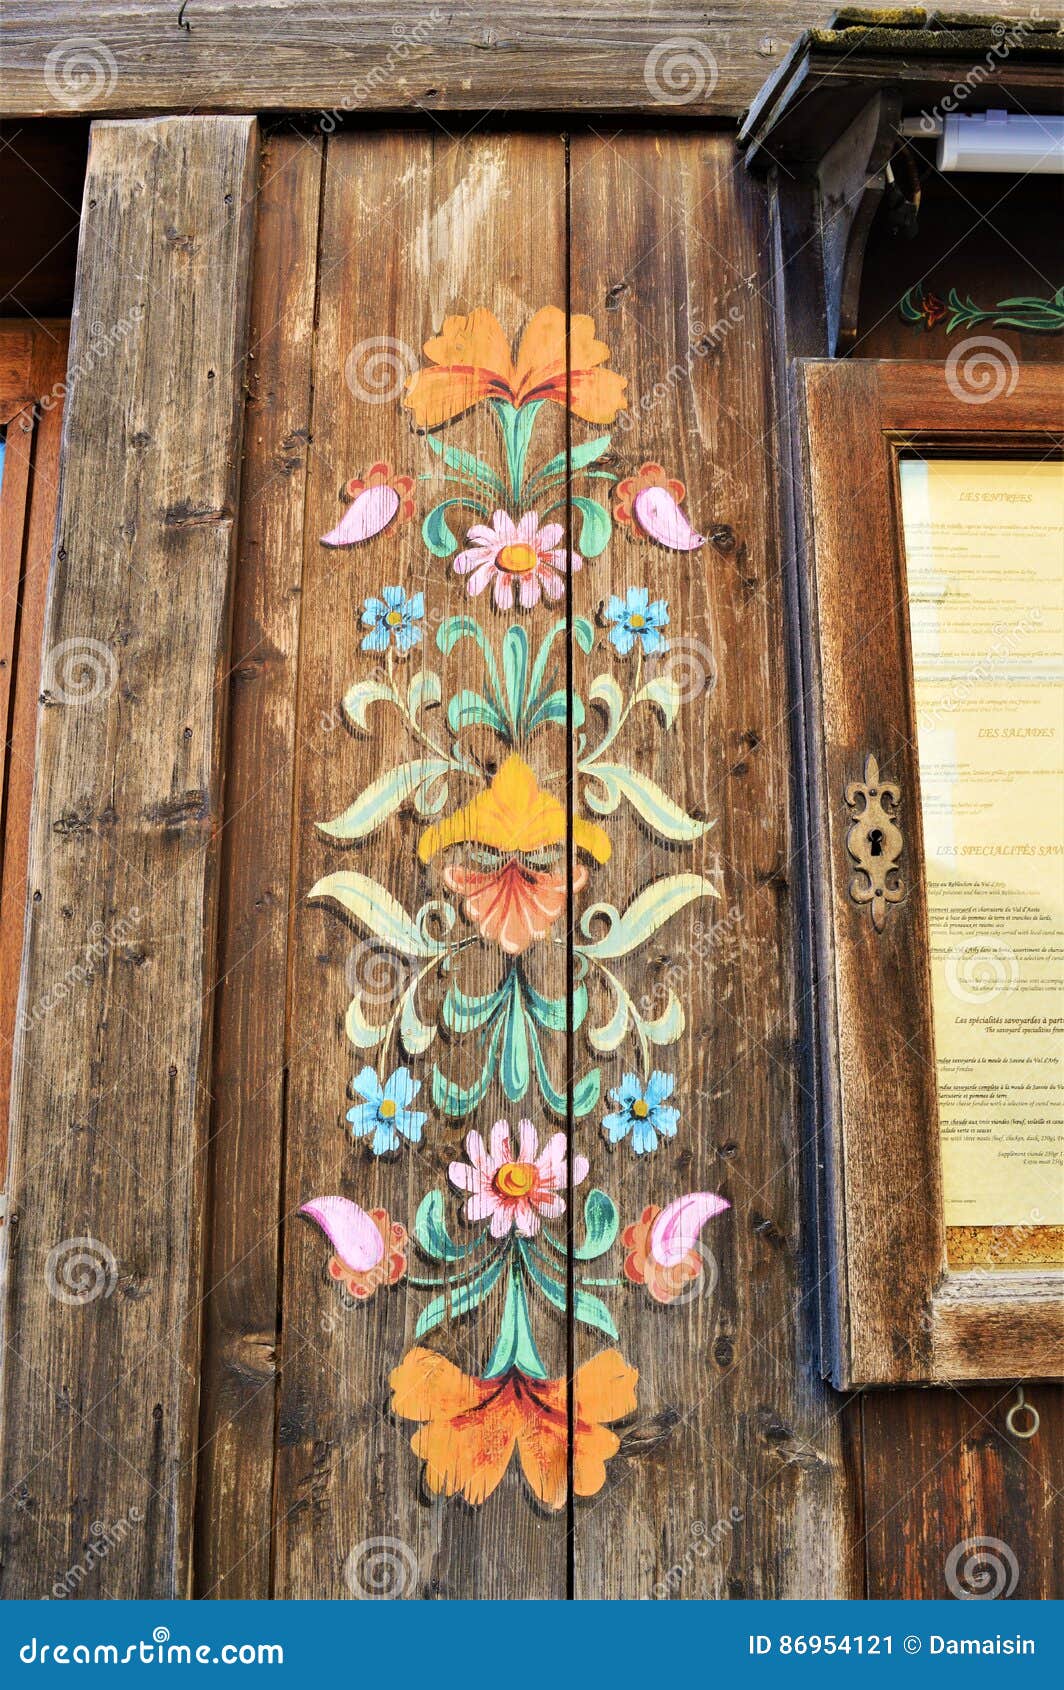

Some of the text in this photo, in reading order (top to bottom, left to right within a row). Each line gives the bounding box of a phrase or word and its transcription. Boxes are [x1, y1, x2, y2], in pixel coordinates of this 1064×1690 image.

[960, 492, 979, 501] LES
[978, 729, 1055, 738] LES SALADES
[936, 846, 959, 855] LES
[969, 1016, 1002, 1025] spécialités
[1004, 1016, 1040, 1025] savoyardes
